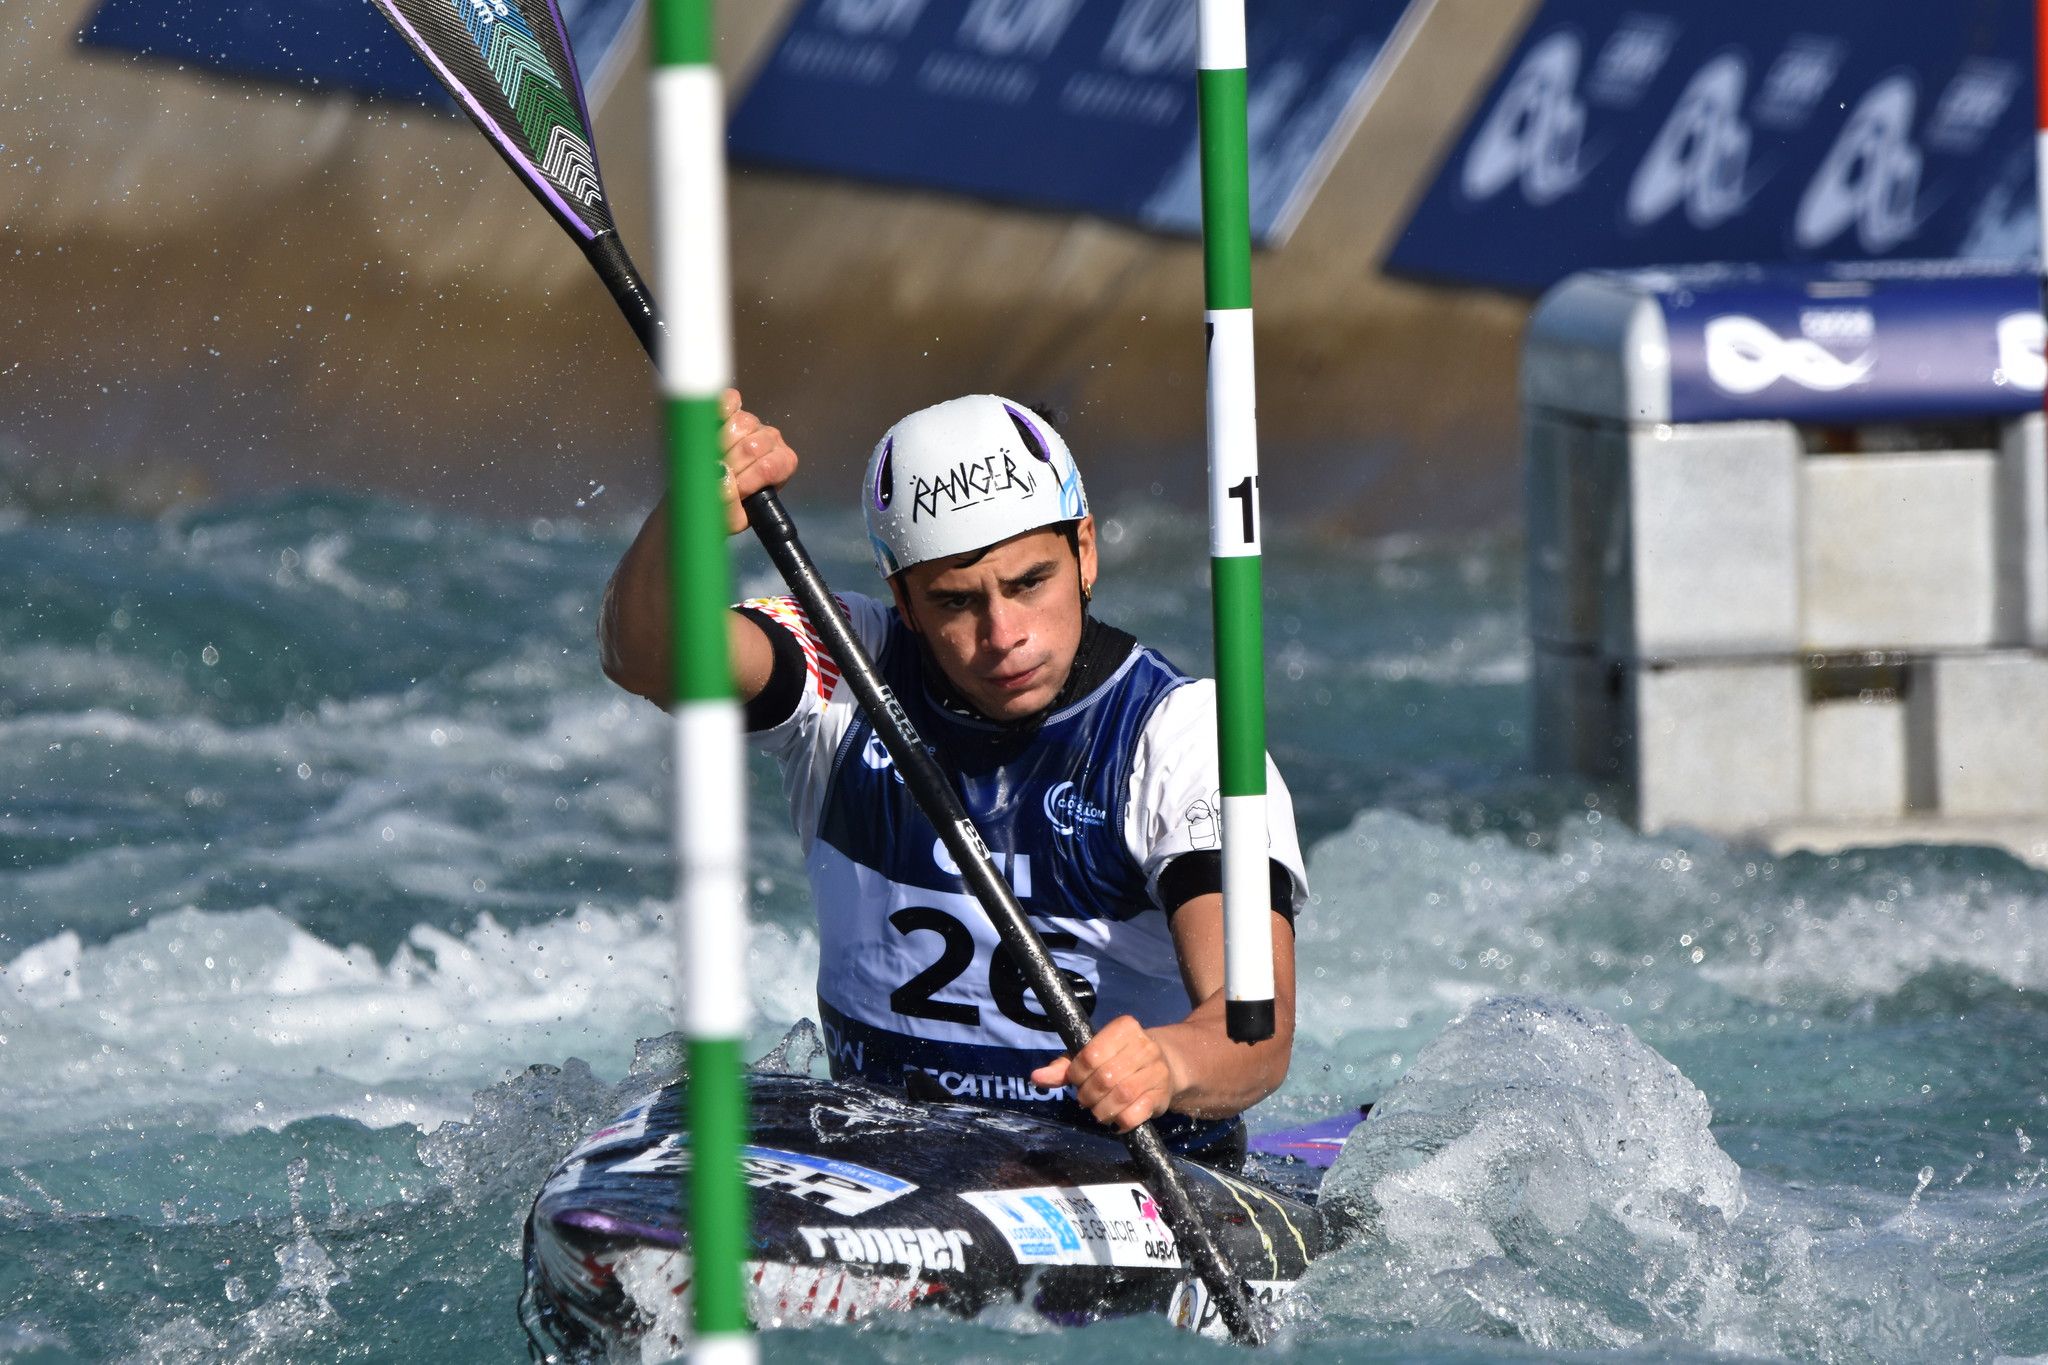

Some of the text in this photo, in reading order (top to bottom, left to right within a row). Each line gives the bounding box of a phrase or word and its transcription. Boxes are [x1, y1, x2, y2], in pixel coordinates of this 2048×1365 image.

[910, 449, 1032, 523] RANGER
[1229, 474, 1259, 543] 1
[889, 906, 1097, 1032] 26
